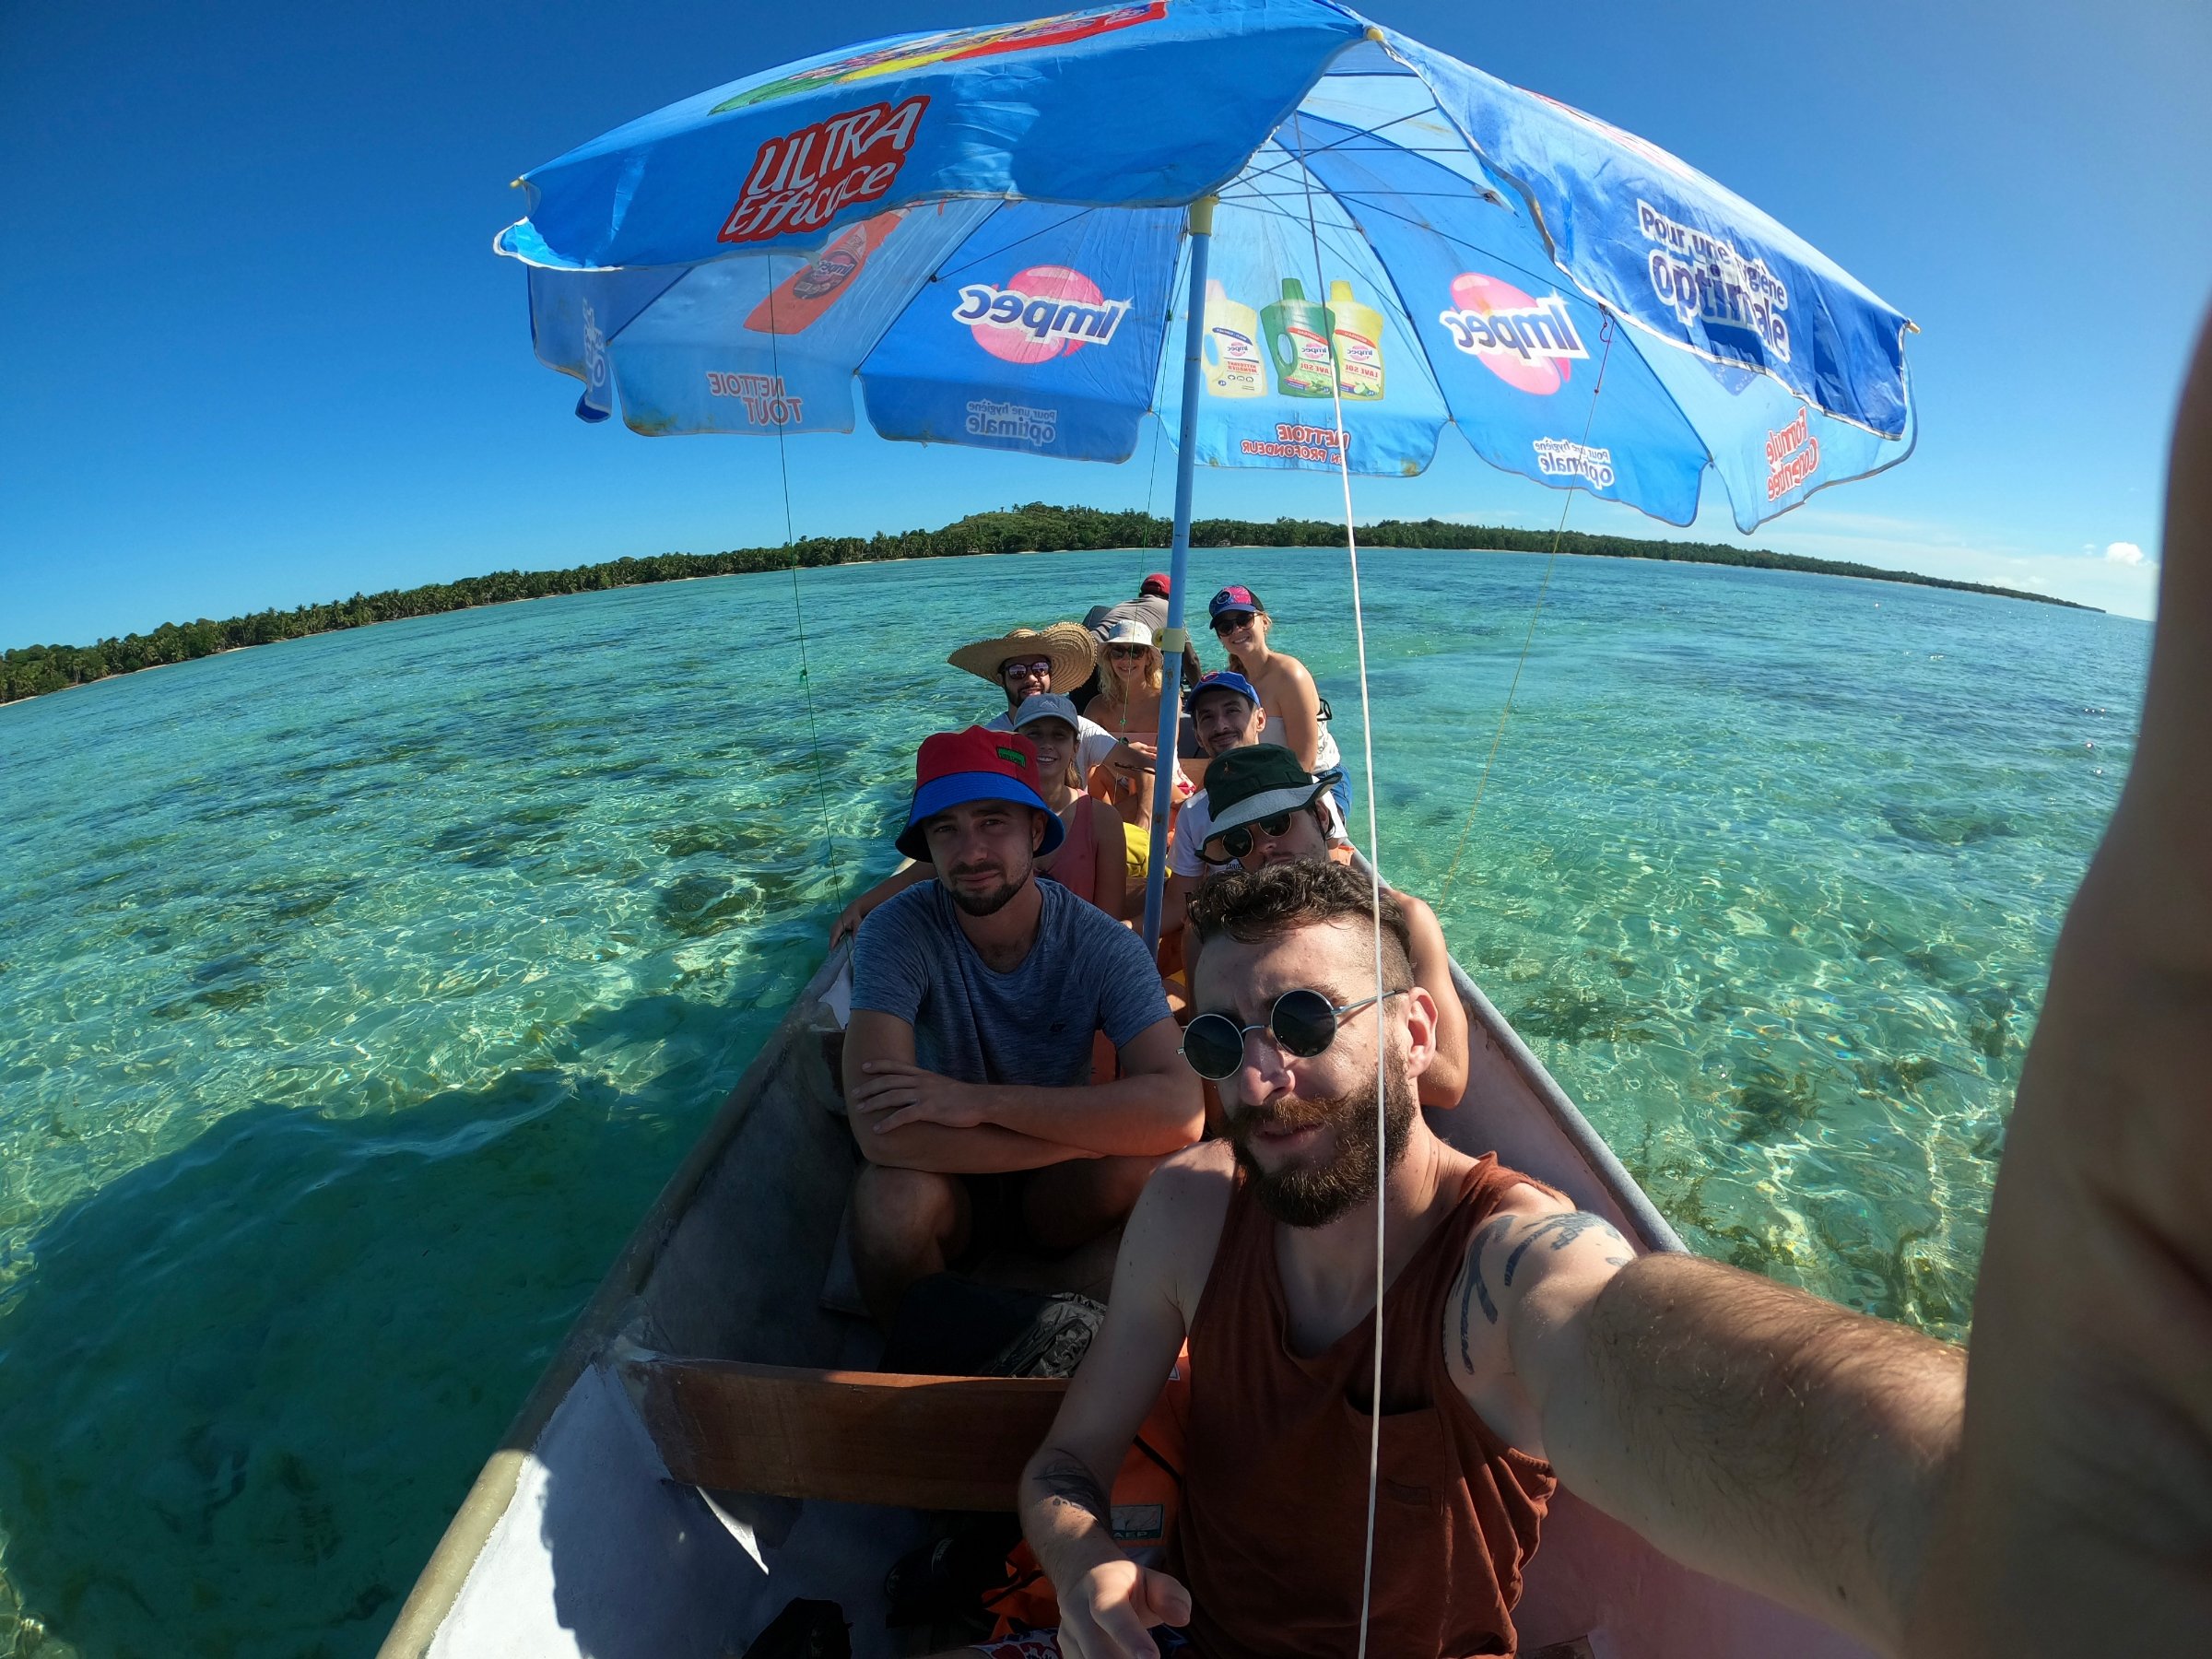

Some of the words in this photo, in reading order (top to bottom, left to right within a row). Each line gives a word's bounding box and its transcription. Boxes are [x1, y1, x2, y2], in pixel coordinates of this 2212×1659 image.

[747, 99, 923, 197] ULTRA
[1641, 205, 1686, 249] Pour
[1693, 233, 1731, 265] une
[1652, 253, 1787, 356] optimale
